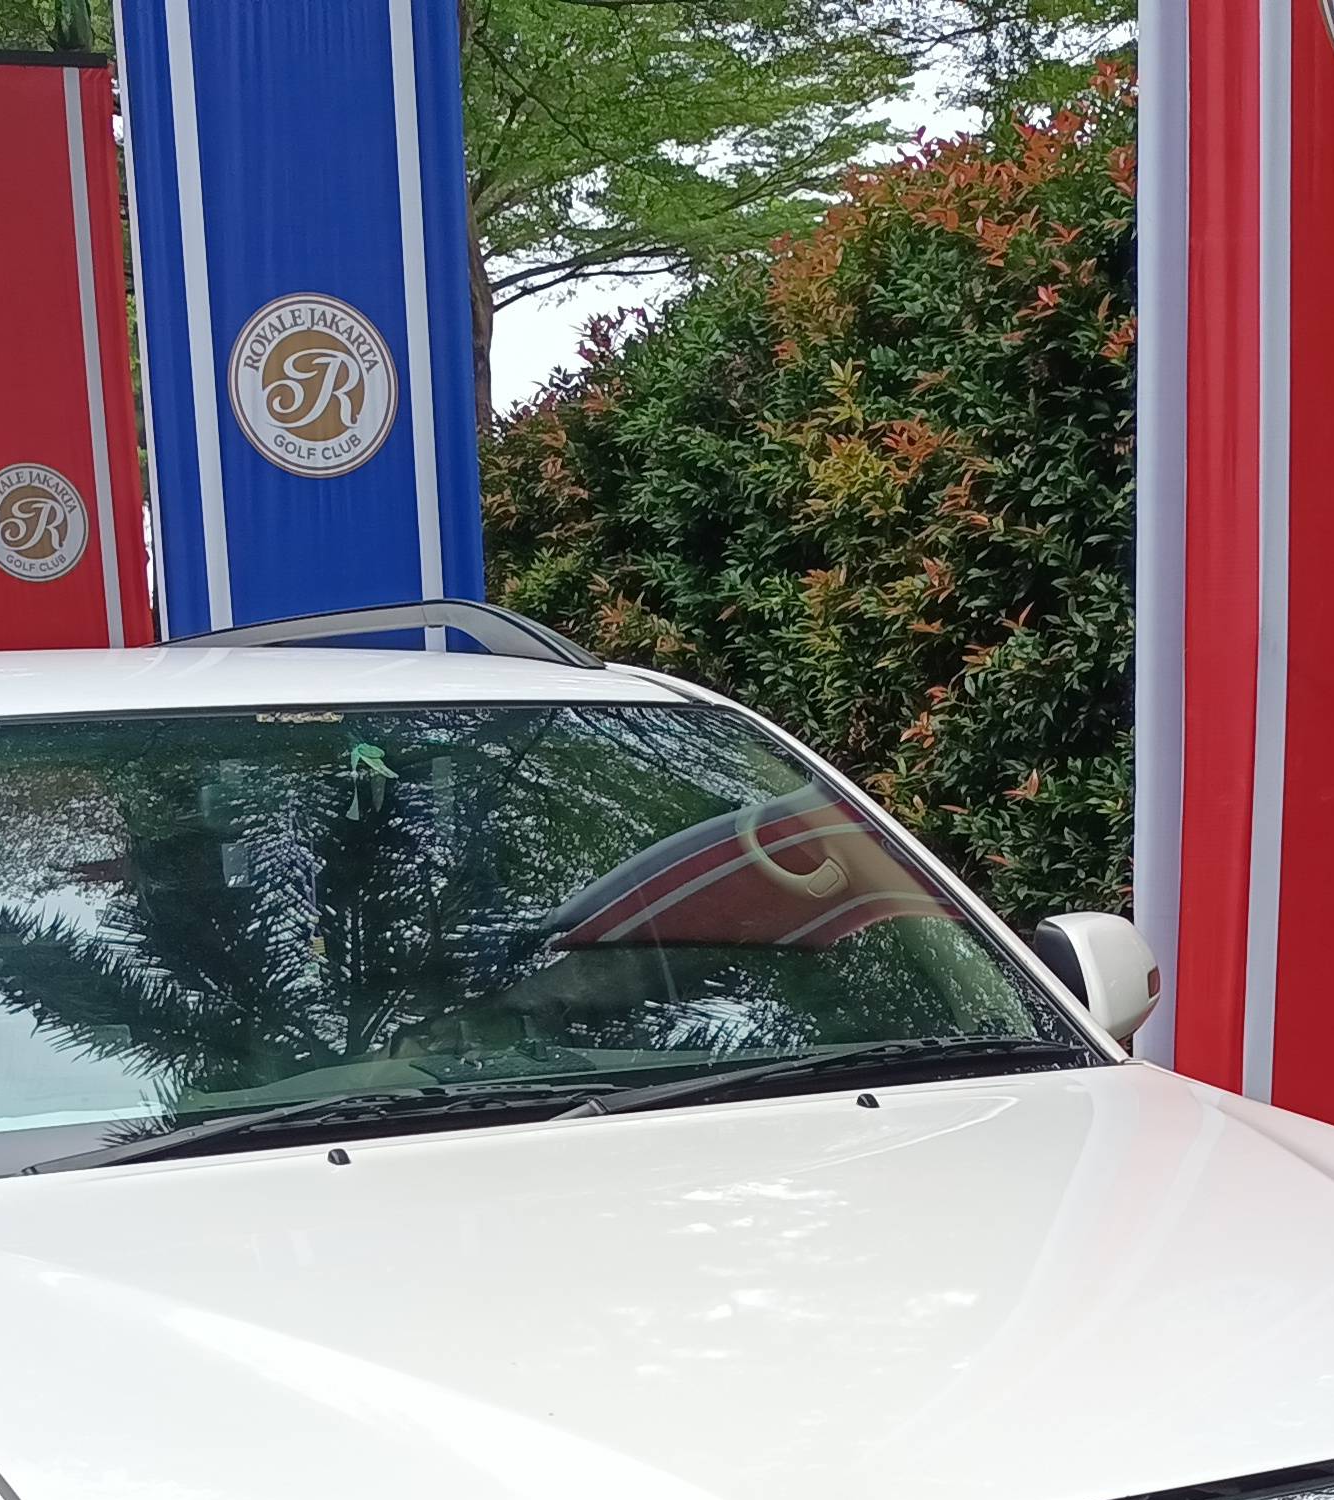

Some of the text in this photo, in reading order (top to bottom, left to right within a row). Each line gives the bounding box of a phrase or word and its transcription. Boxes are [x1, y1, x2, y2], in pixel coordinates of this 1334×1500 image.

[243, 307, 380, 374] ROYALE JAKARTA
[273, 433, 362, 460] GOLF CLUB
[27, 470, 78, 514] JAKARTA
[6, 554, 67, 573] GOLF CLUB
